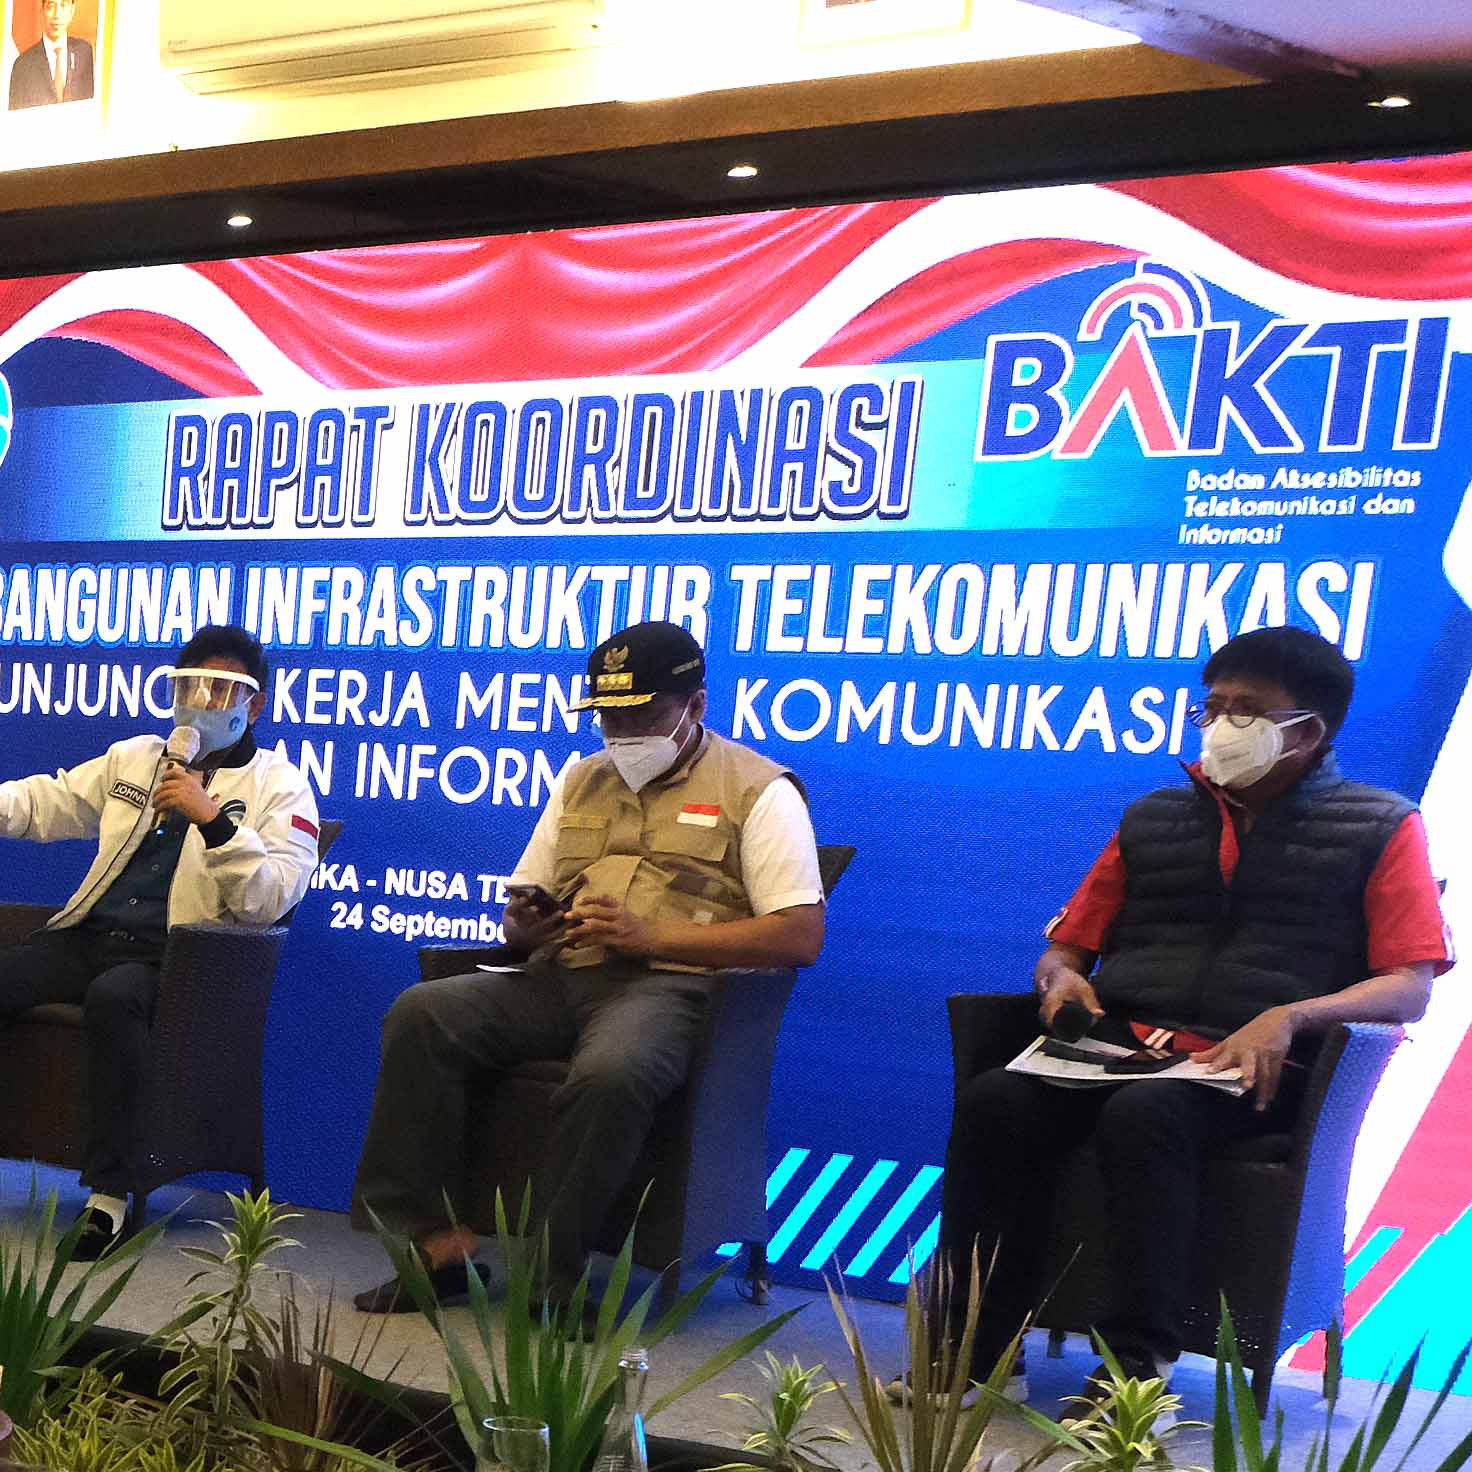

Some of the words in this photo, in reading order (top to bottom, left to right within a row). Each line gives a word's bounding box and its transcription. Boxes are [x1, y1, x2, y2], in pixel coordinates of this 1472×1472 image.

[975, 316, 1452, 462] BAKTI
[162, 405, 396, 530] RAPAT
[403, 374, 924, 528] KOORDINASI
[1185, 468, 1265, 491] Badan
[1269, 465, 1422, 489] Aksesibilitas
[1183, 495, 1356, 517] Telekomunikasi
[1362, 492, 1416, 515] dan
[1178, 522, 1284, 545] Informasi
[245, 562, 712, 650] INFRASTRUKTUR
[728, 562, 1378, 660] TELEKOMUNIKASI
[272, 667, 430, 728] KERJA
[731, 677, 1189, 756] KOMUNIKASI
[273, 738, 335, 796] AN
[355, 741, 580, 807] INFORM
[384, 867, 469, 901] NUSA
[330, 901, 365, 931] 24
[370, 904, 507, 944] Septemb
